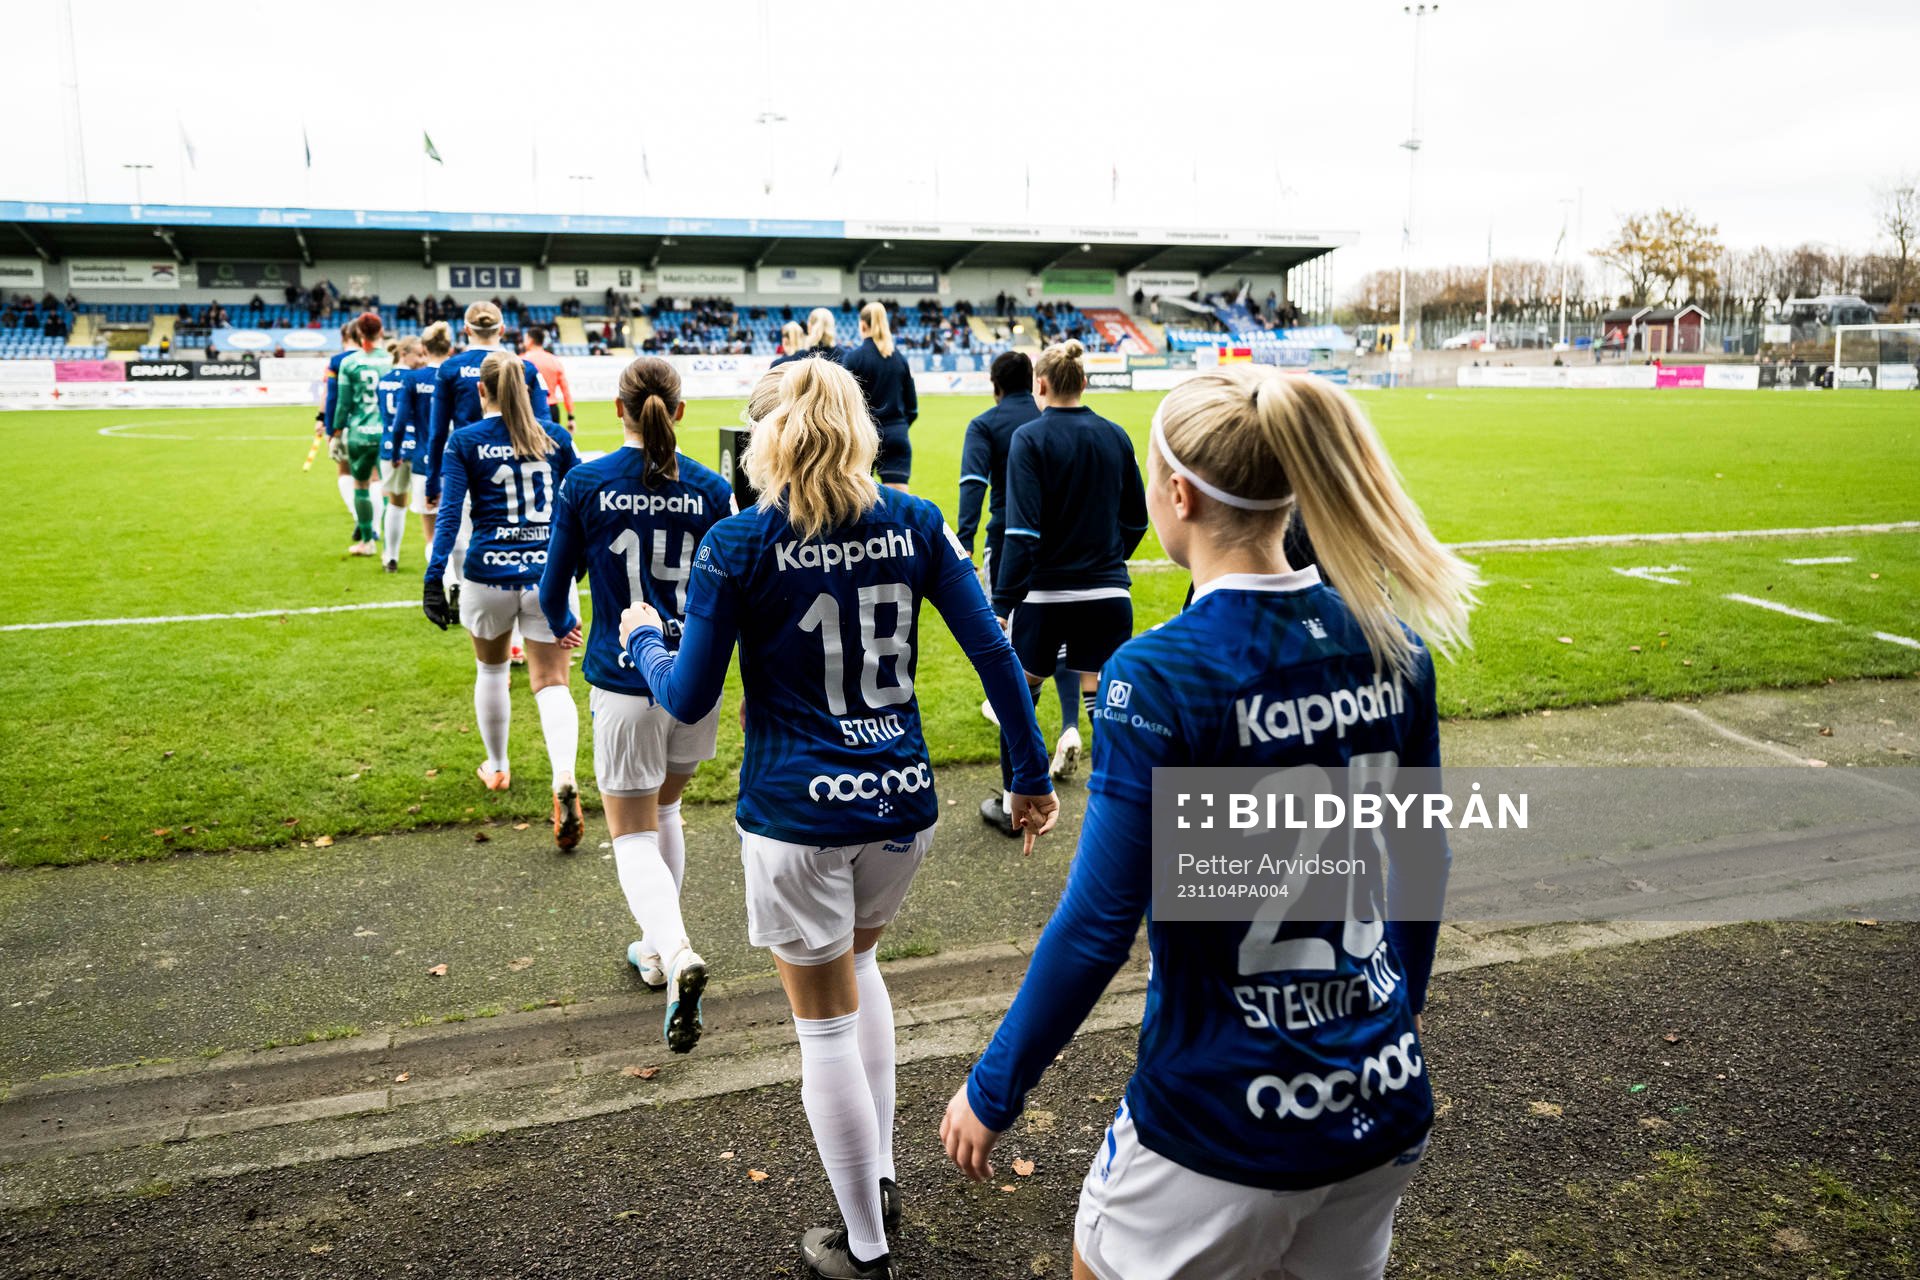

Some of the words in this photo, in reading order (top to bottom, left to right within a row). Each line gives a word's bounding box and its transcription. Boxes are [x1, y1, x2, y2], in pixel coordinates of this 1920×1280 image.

[455, 271, 516, 286] TCT
[130, 364, 177, 377] CRAFT
[199, 364, 245, 376] CRAFT
[490, 461, 553, 524] 10
[599, 490, 703, 516] Kappahl
[775, 528, 915, 573] Kappahl
[608, 528, 694, 616] 14
[797, 582, 914, 716] 18
[1235, 671, 1405, 748] Kappahl
[881, 843, 912, 854] Rail
